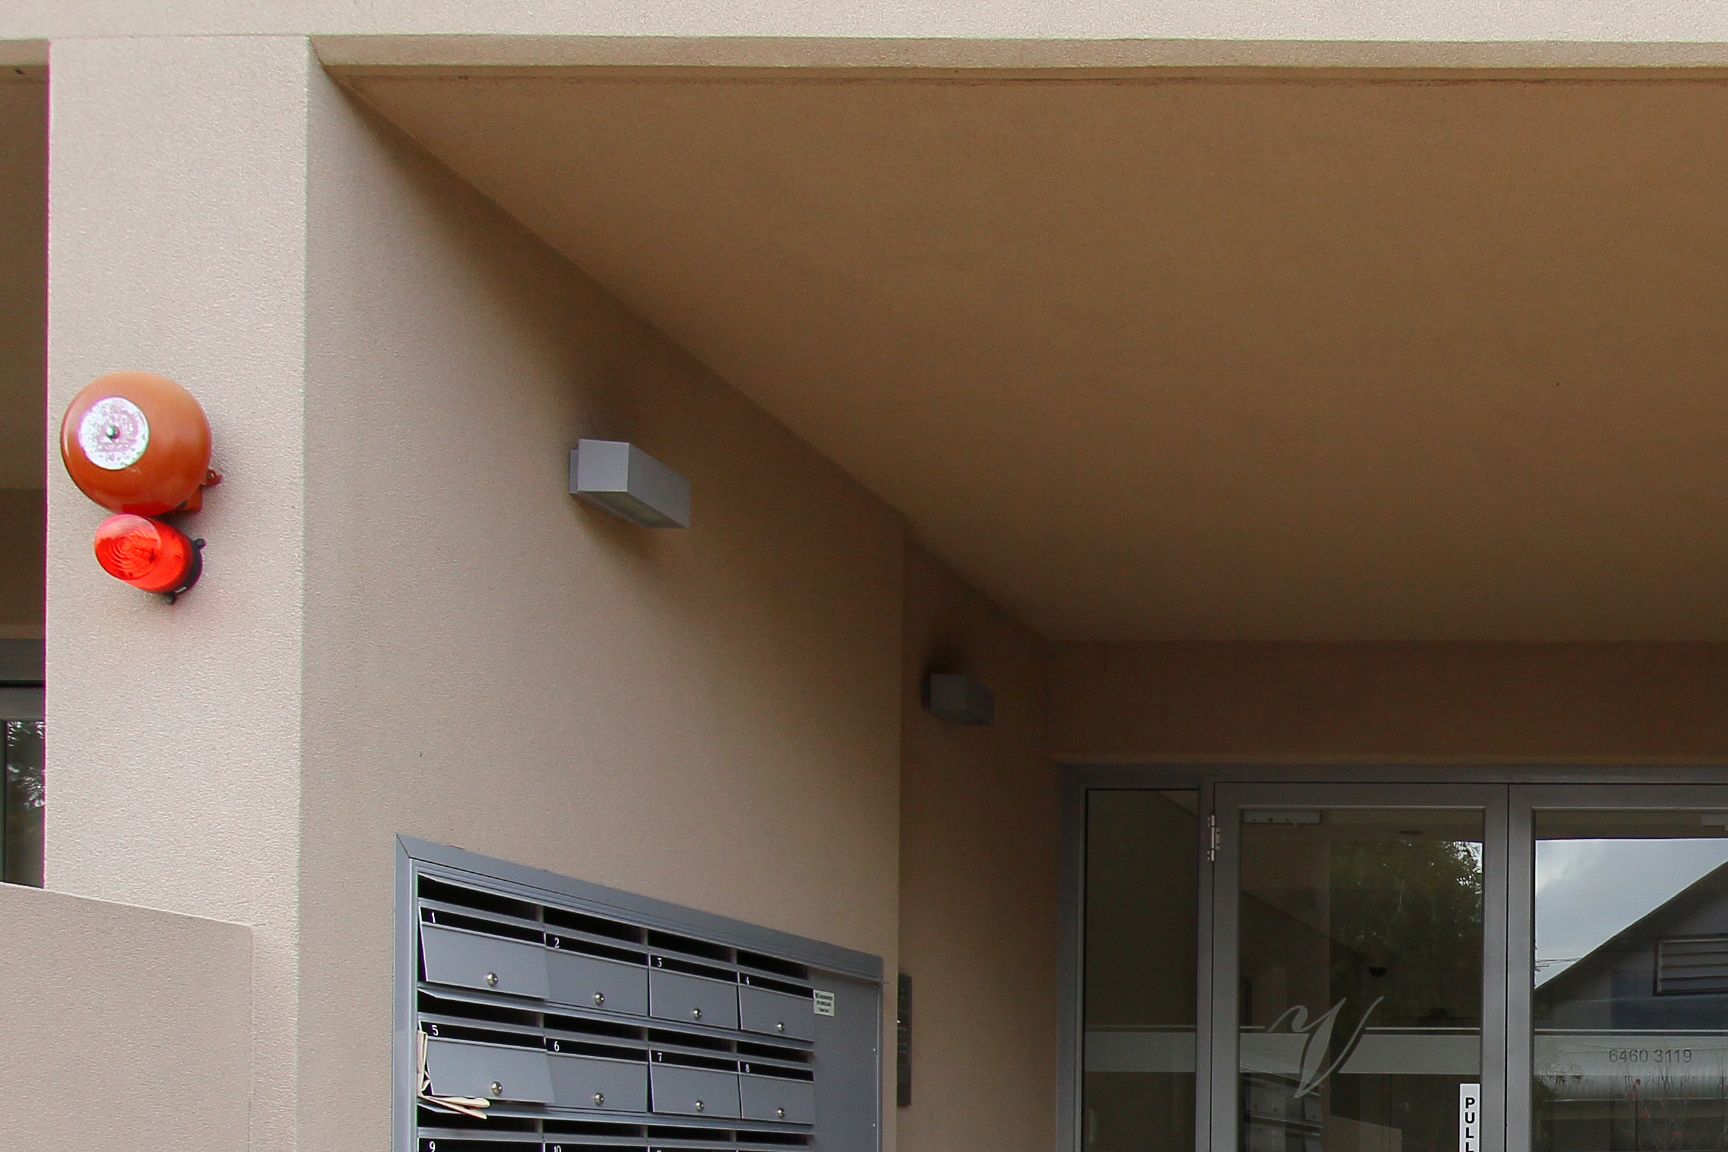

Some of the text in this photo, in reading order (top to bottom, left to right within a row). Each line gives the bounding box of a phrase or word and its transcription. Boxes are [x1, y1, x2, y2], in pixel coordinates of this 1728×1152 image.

[431, 911, 437, 924] 1
[554, 937, 561, 949] 2
[657, 957, 663, 968] 3
[745, 976, 750, 986] 4
[431, 1024, 439, 1036] 5
[554, 1040, 560, 1052] 6
[657, 1052, 664, 1063] 7
[1608, 1049, 1649, 1063] 6460
[745, 1063, 750, 1074] 8
